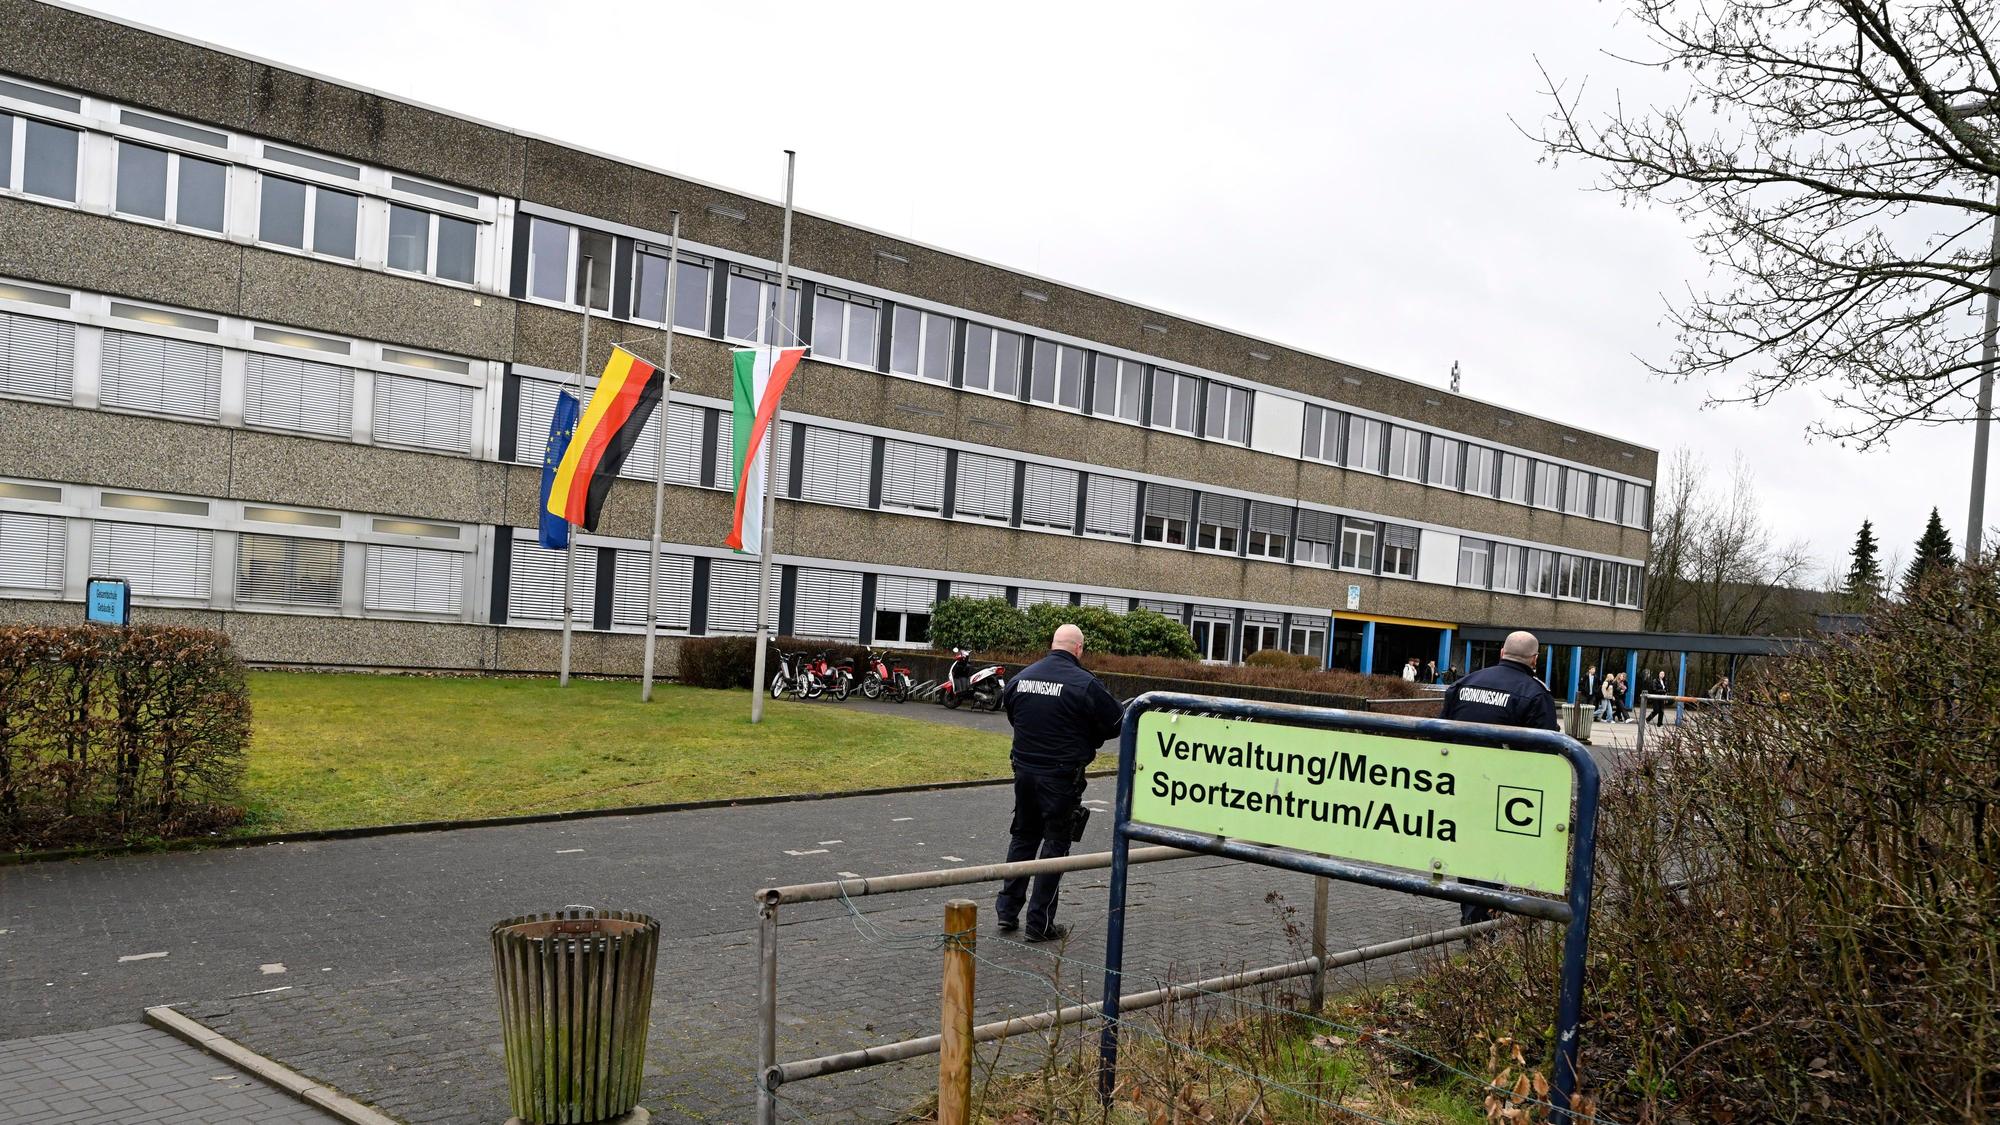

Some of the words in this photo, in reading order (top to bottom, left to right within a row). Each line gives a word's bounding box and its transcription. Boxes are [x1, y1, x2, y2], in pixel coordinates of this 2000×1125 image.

[1017, 679, 1064, 697] ORDNUNGSAMT
[1459, 687, 1511, 708] ORDNUNGSAMT
[1156, 731, 1456, 796] Verwaltung/Mensa
[1151, 771, 1457, 843] Sportzentrum/Aula
[1504, 797, 1535, 827] C
